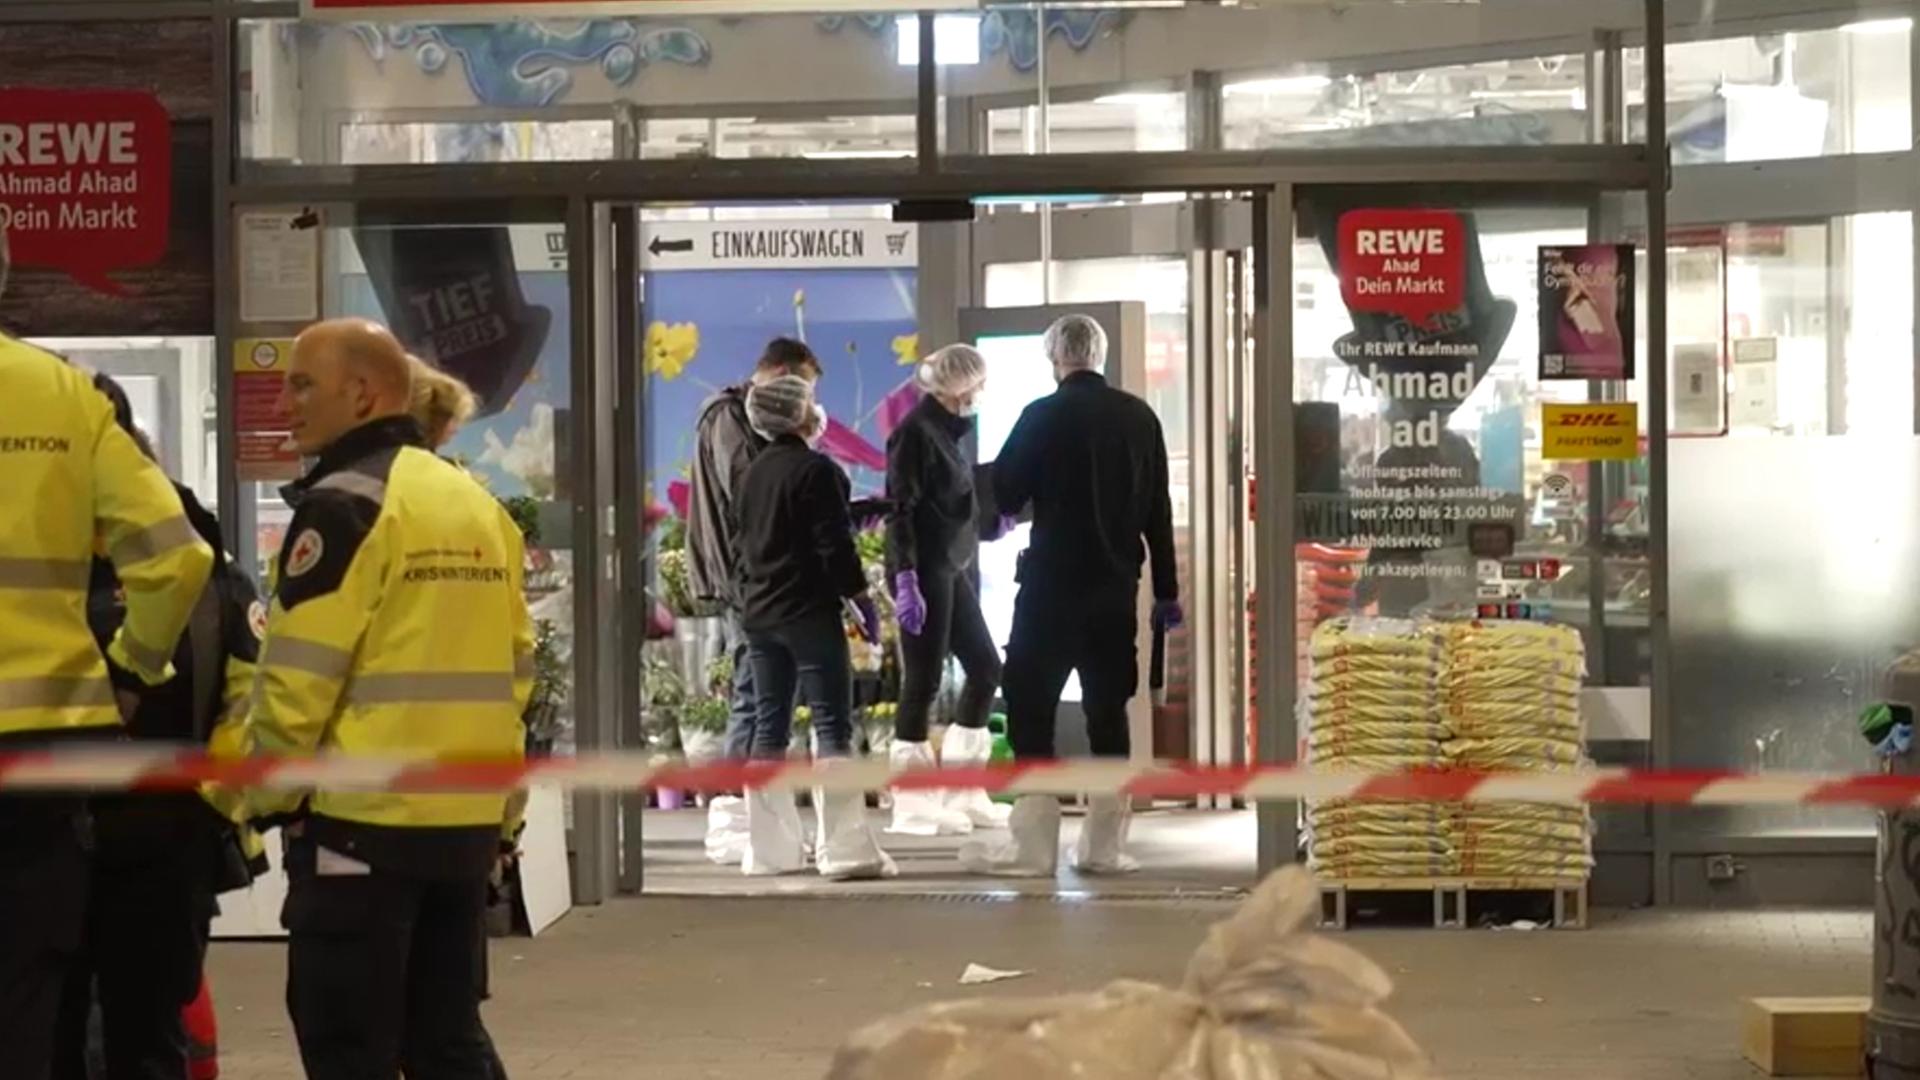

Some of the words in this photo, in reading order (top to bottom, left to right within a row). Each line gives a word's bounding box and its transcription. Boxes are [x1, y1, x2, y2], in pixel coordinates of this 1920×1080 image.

[0, 121, 138, 165] REWE
[79, 169, 138, 194] Ahad
[59, 201, 138, 229] Markt
[711, 229, 865, 259] EINKAUFSWAGEN
[1356, 229, 1445, 255] REWE
[1382, 258, 1420, 273] Ahad
[1356, 277, 1392, 294] Dein
[1396, 276, 1445, 294] Markt
[409, 272, 494, 331] TIEF
[1340, 342, 1362, 356] Ihr
[1364, 342, 1405, 356] REWE
[1408, 341, 1480, 356] Kaufmann
[1343, 362, 1475, 400] Ahmad
[1560, 412, 1619, 426] DHL
[1556, 436, 1624, 447] PAKETSHOP
[1351, 463, 1463, 480] Öffnungszeiten:
[1414, 485, 1436, 499] bis
[1351, 508, 1377, 519] von
[1381, 506, 1416, 520] 7.00
[1419, 506, 1440, 519] bis
[1443, 506, 1488, 520] 23.00
[1491, 505, 1516, 519] Uhr
[1351, 534, 1443, 549] Abholservice
[1351, 564, 1374, 577] Wir
[1377, 563, 1467, 579] akzeptieren:
